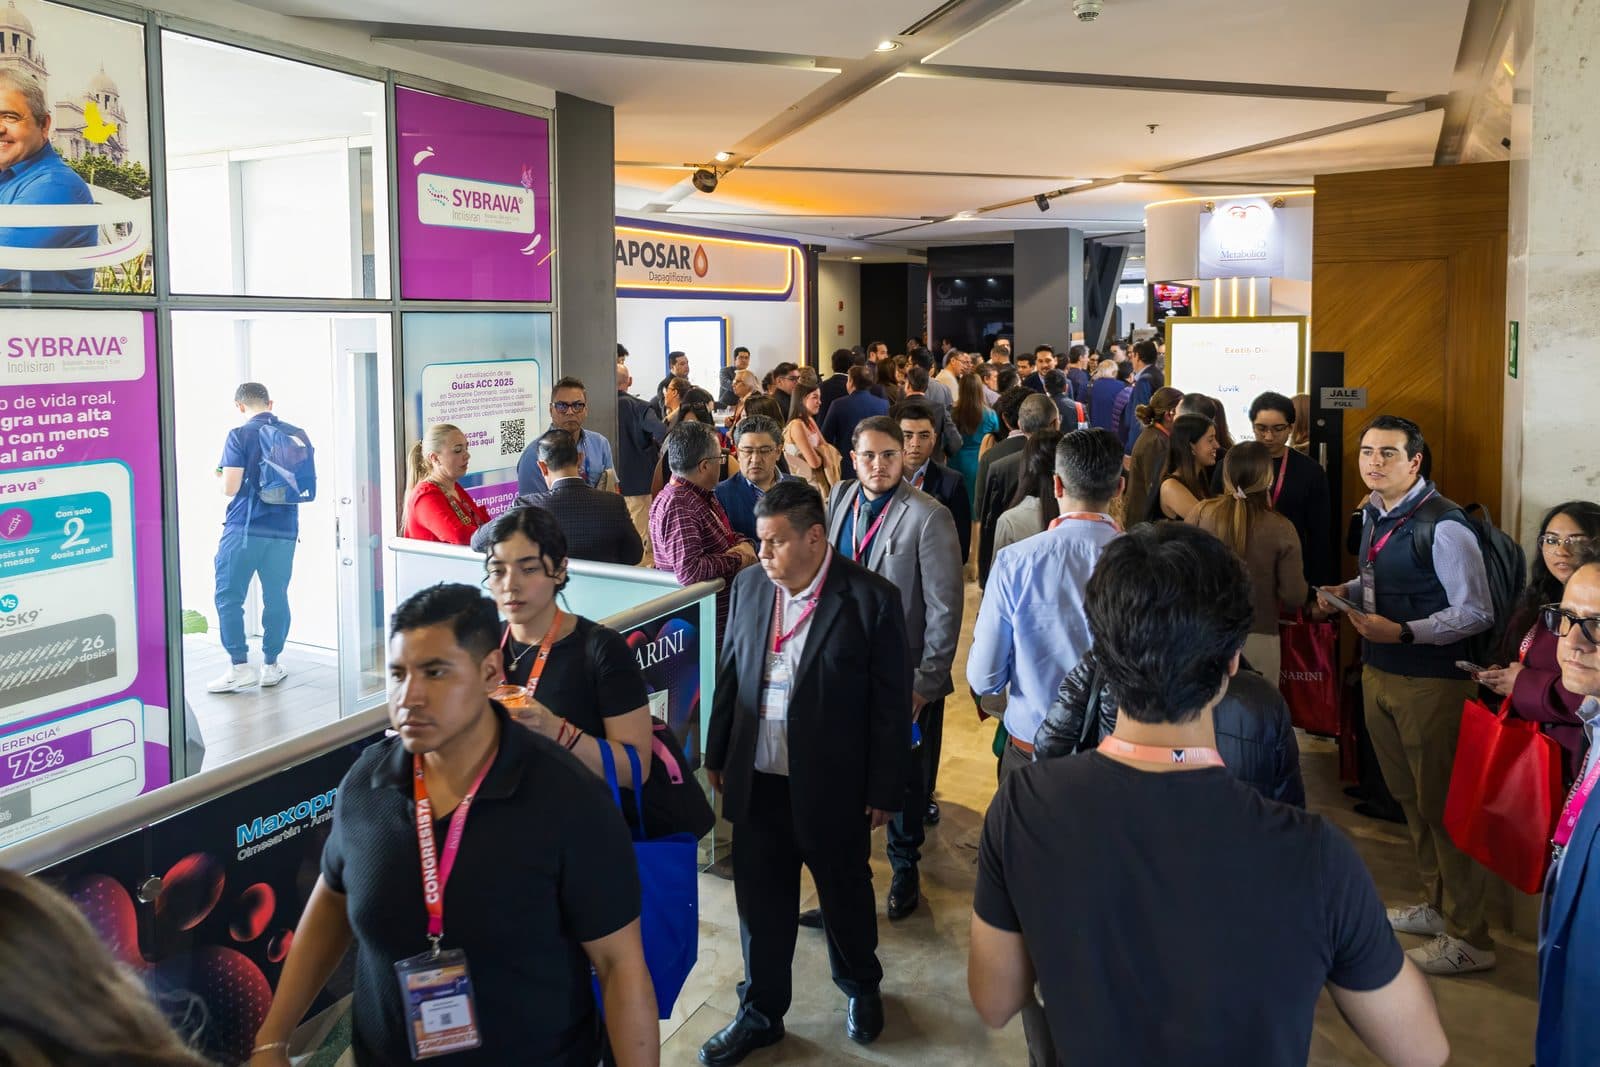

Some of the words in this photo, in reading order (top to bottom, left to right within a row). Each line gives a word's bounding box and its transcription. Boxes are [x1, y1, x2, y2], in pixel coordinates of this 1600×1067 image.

[616, 239, 691, 270] APOSAR
[649, 272, 692, 284] Dapagliflozina
[8, 360, 55, 373] Inclisiran
[452, 381, 475, 391] Guías
[476, 379, 493, 388] ACC
[494, 378, 514, 387] 2025
[14, 395, 36, 409] de
[40, 393, 77, 407] vida
[81, 391, 116, 405] real,
[38, 413, 73, 425] una
[77, 408, 112, 422] alta
[8, 432, 44, 445] con
[49, 427, 109, 441] menos
[480, 436, 495, 446] aquí
[55, 510, 73, 518] Con
[73, 507, 93, 515] solo
[60, 517, 90, 550] 2
[25, 547, 40, 555] los
[51, 551, 75, 560] dosis
[76, 548, 84, 556] al
[3, 557, 35, 568] meses
[81, 635, 104, 652] 26
[636, 629, 685, 670] ARINI
[8, 746, 64, 779] 79%
[417, 798, 440, 904] CONGRESISTA
